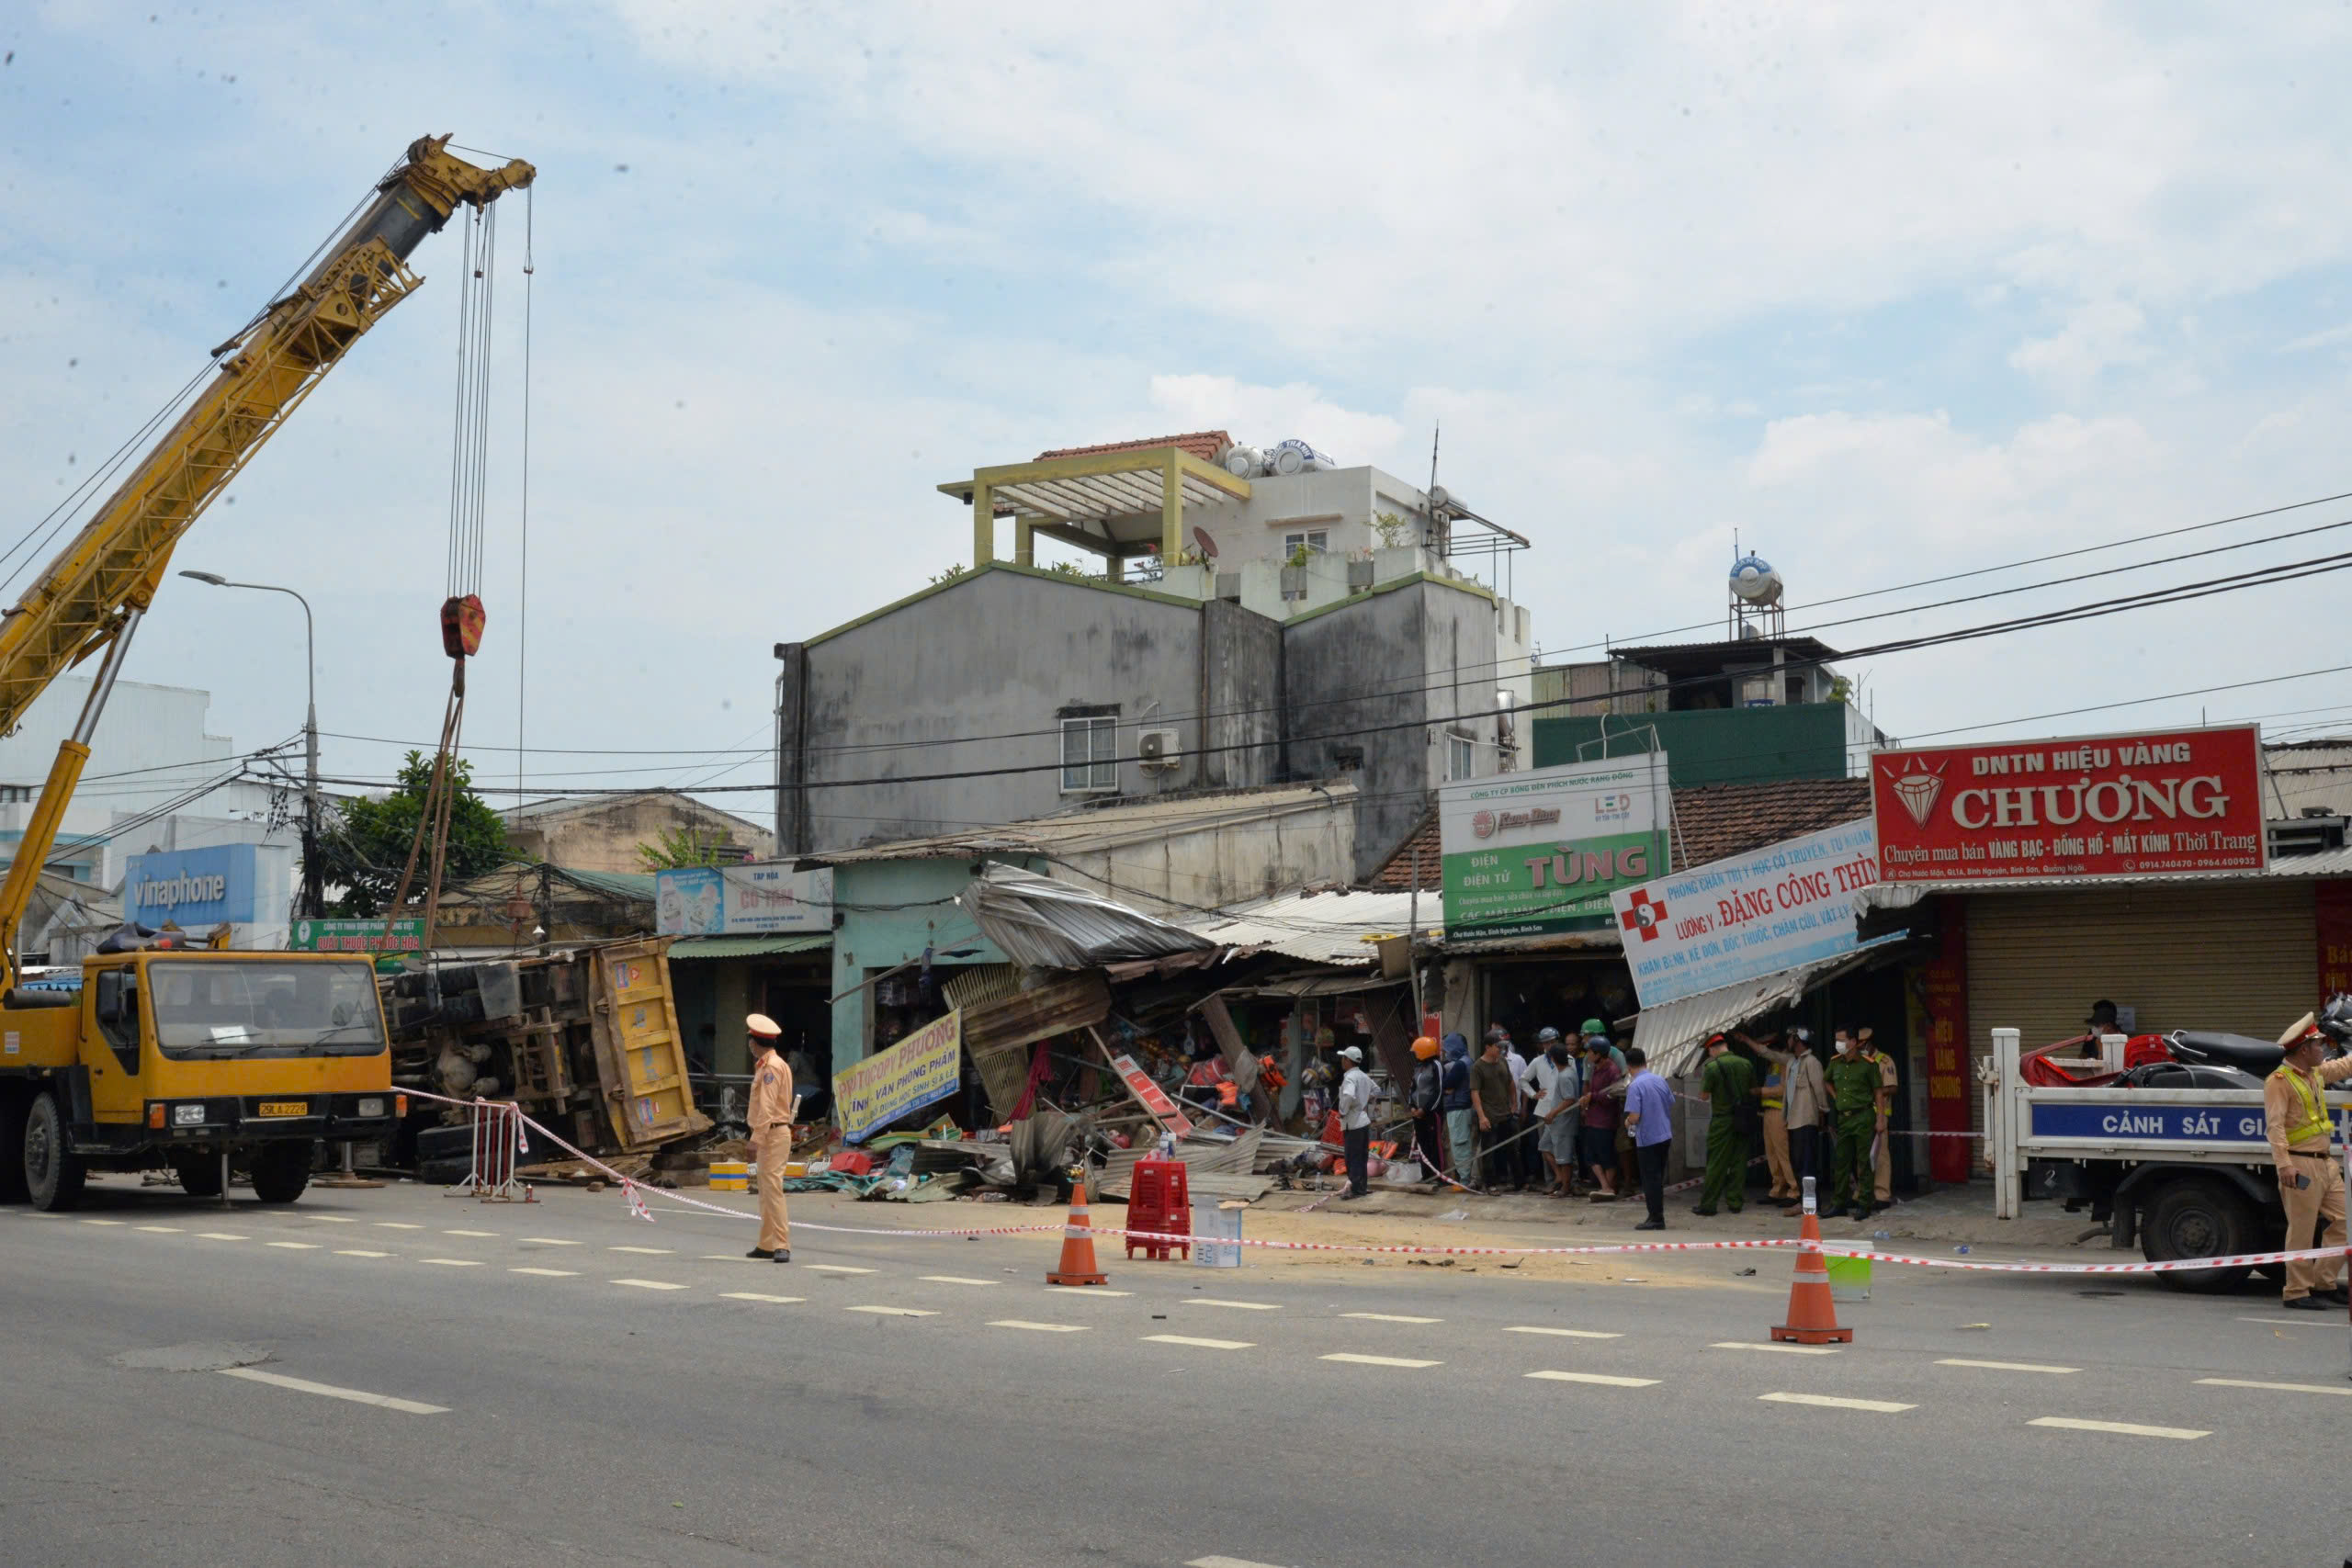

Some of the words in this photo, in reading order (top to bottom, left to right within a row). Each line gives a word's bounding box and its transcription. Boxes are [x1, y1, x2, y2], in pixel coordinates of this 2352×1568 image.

[1973, 752, 2045, 776] DNTN
[2052, 745, 2111, 773] HIỆU
[2118, 741, 2191, 766] VÀNG
[1595, 794, 1631, 814] LED
[1951, 773, 2230, 829] CHƯƠNG
[1883, 844, 1929, 865] Chuyên
[1933, 848, 1959, 861] mua
[1962, 842, 1985, 860] bán
[1988, 838, 2018, 859] VÀNG
[2021, 840, 2043, 861] BẠC
[2053, 832, 2084, 856] ĐỒNG
[2088, 831, 2103, 855] HỒ
[2113, 829, 2137, 853] MẮT
[2142, 830, 2170, 852] KÍNH
[2174, 831, 2208, 852] Thời
[2211, 830, 2256, 852] Trang
[1470, 853, 1498, 868] ĐIỆN
[1524, 845, 1647, 888] TÙNG
[2139, 859, 2192, 869] 0914.740470
[134, 868, 226, 911] vinaphone
[1464, 874, 1491, 888] ĐIỆN
[1494, 870, 1510, 884] TỬ
[1706, 913, 1715, 931] Y
[1719, 888, 1773, 930] ĐẶNG
[1777, 873, 1831, 909] CÔNG
[369, 931, 400, 950] PHỚC
[876, 1081, 894, 1100] VĂN
[2102, 1110, 2164, 1134] CẢNH
[2182, 1111, 2221, 1135] SÁT
